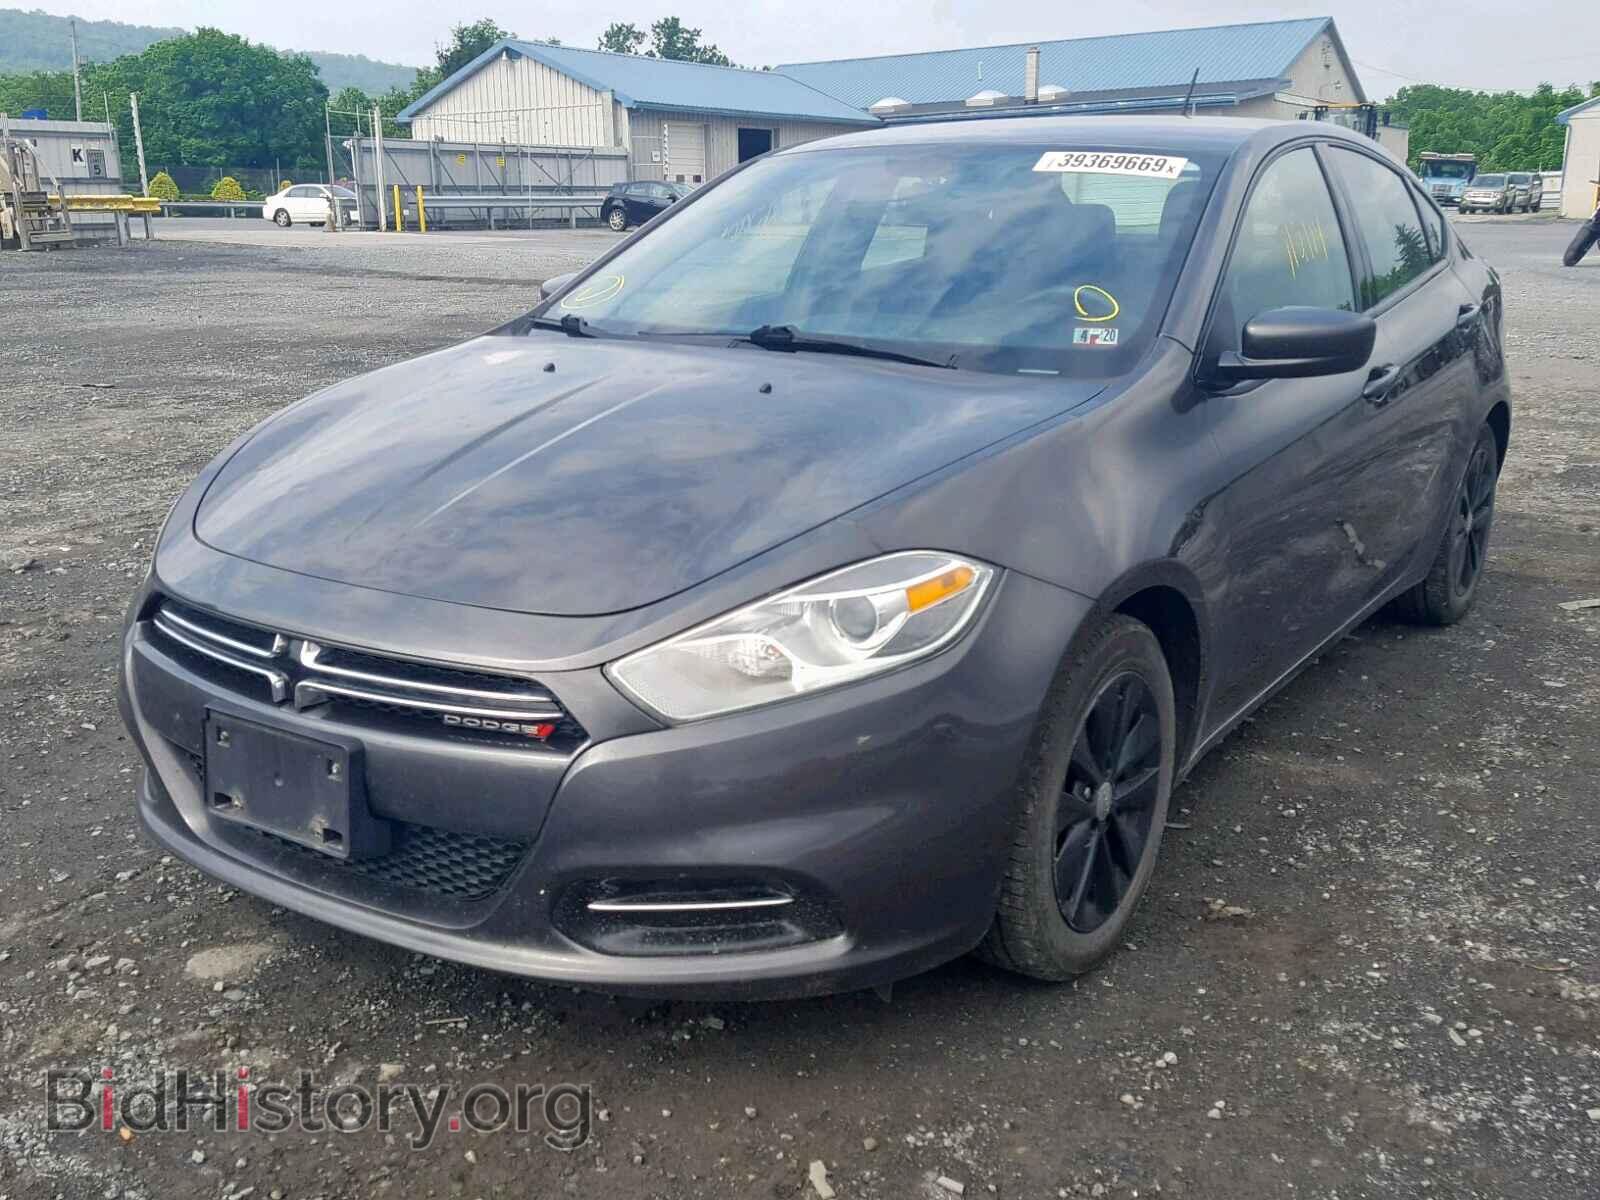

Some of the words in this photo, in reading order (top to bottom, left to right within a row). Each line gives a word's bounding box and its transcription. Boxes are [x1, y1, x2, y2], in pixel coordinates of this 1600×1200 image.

[72, 148, 83, 162] K
[1103, 329, 1116, 342] 20
[443, 714, 539, 735] DODGE
